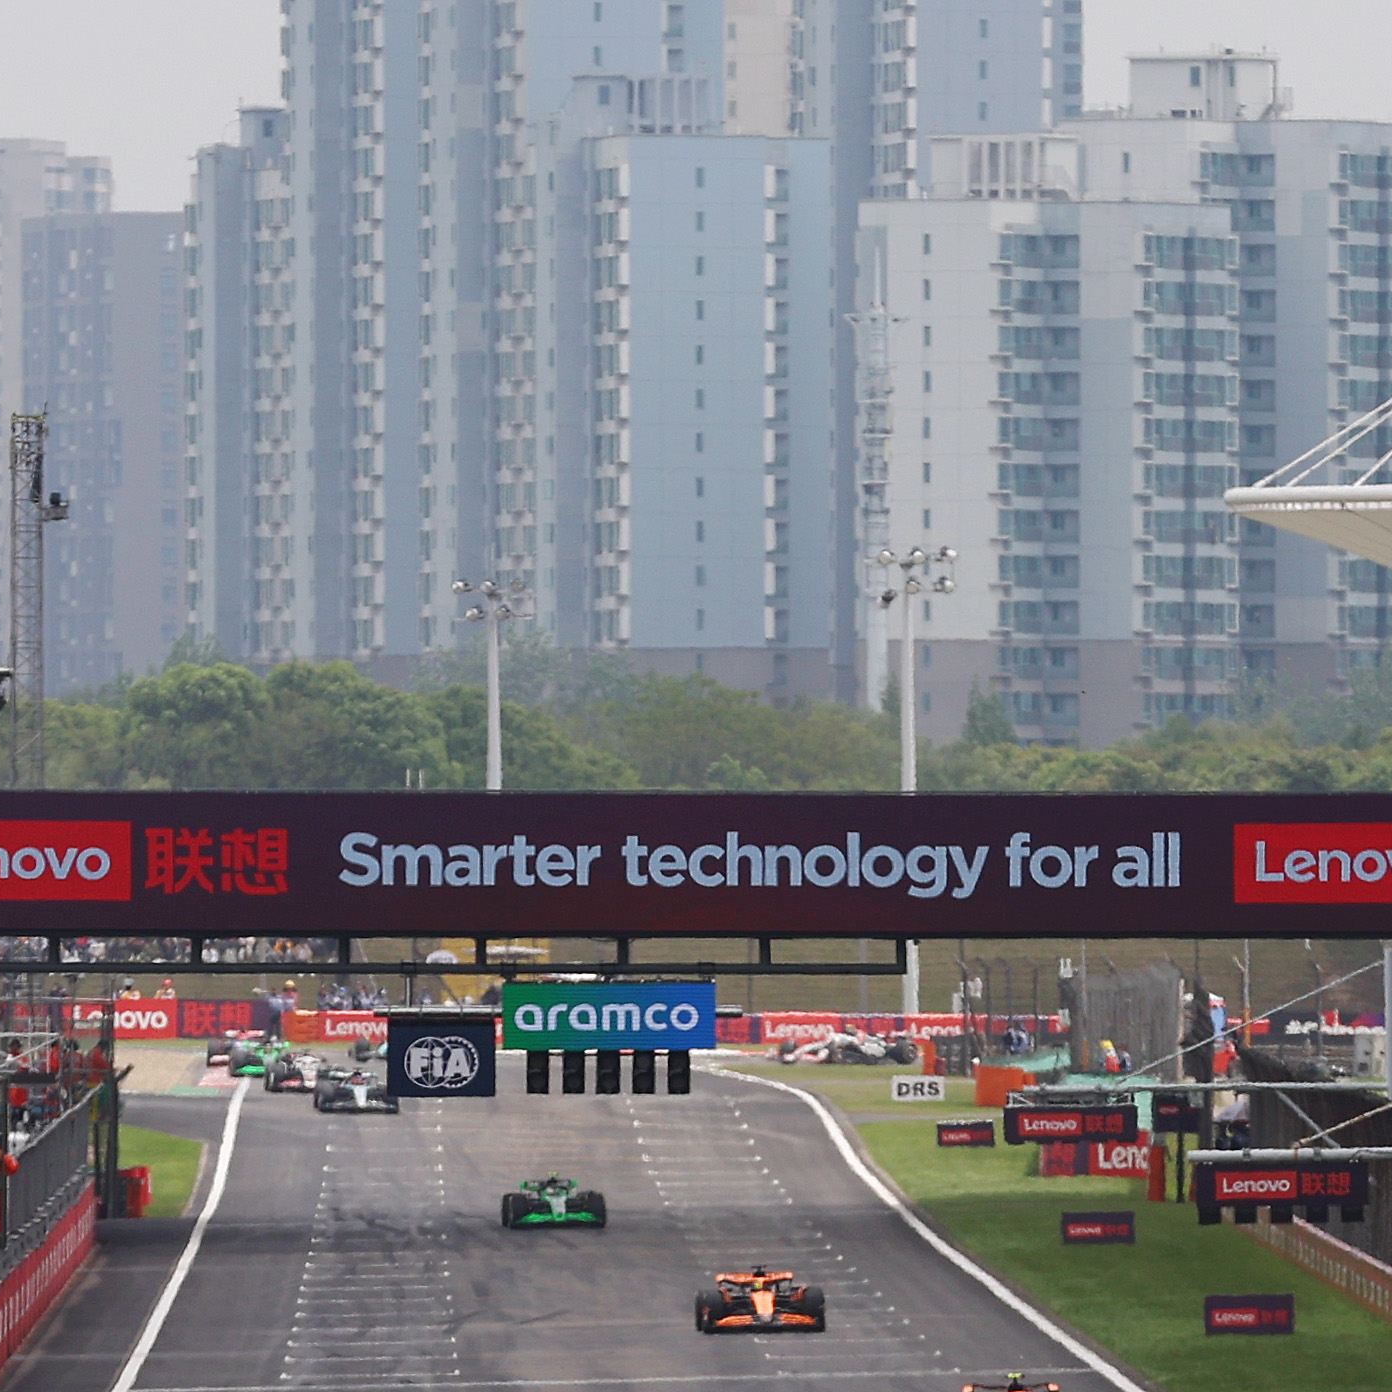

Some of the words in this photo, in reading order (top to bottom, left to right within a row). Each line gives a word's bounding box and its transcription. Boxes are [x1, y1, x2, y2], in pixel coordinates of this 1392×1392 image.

[144, 828, 289, 895] 联想
[339, 831, 601, 887] Smarter
[621, 832, 989, 899] technology
[1005, 832, 1099, 887] for
[1112, 832, 1180, 887] all
[514, 1002, 700, 1032] aramco
[897, 1081, 941, 1097] DRS
[1024, 1116, 1077, 1131] Lenovo
[1222, 1177, 1290, 1194] Lenovo
[1300, 1172, 1351, 1195] 联想
